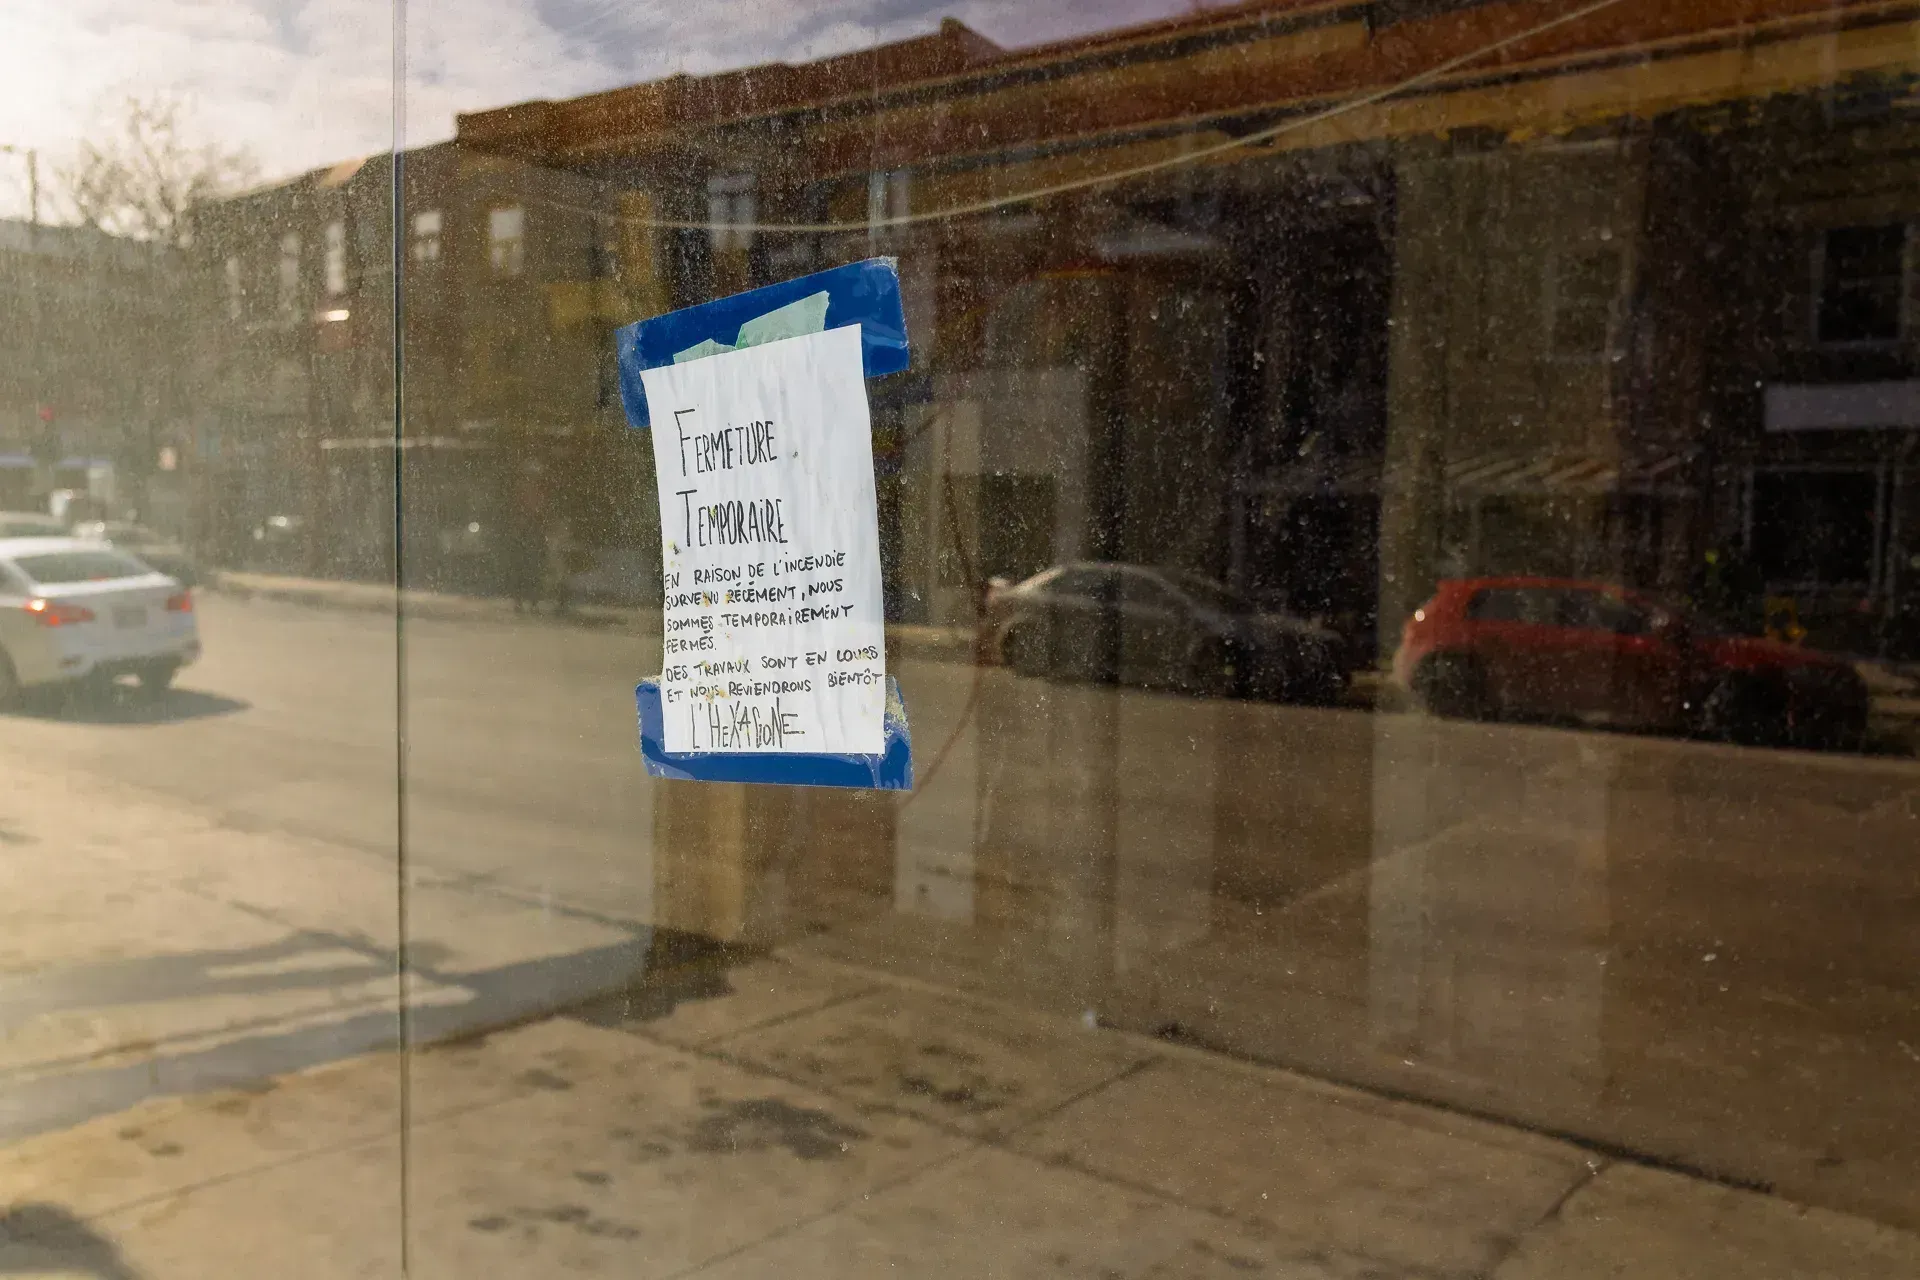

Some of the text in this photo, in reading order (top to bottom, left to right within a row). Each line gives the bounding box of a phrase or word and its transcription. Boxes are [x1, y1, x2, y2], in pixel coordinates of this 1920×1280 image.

[674, 408, 778, 477] FERMETURE
[665, 572, 680, 590] EN
[694, 563, 741, 585] RAISON
[748, 562, 765, 578] DE
[665, 590, 719, 611] SURVENU
[808, 578, 843, 597] NOUS
[667, 615, 714, 633] SOMMES
[666, 665, 688, 682] DES
[693, 659, 751, 677] TRAVAUX
[760, 655, 798, 669] SONT
[805, 650, 827, 666] EN
[666, 688, 684, 703] ET
[690, 684, 720, 698] NOUS
[728, 678, 811, 697] REVIENDRONS
